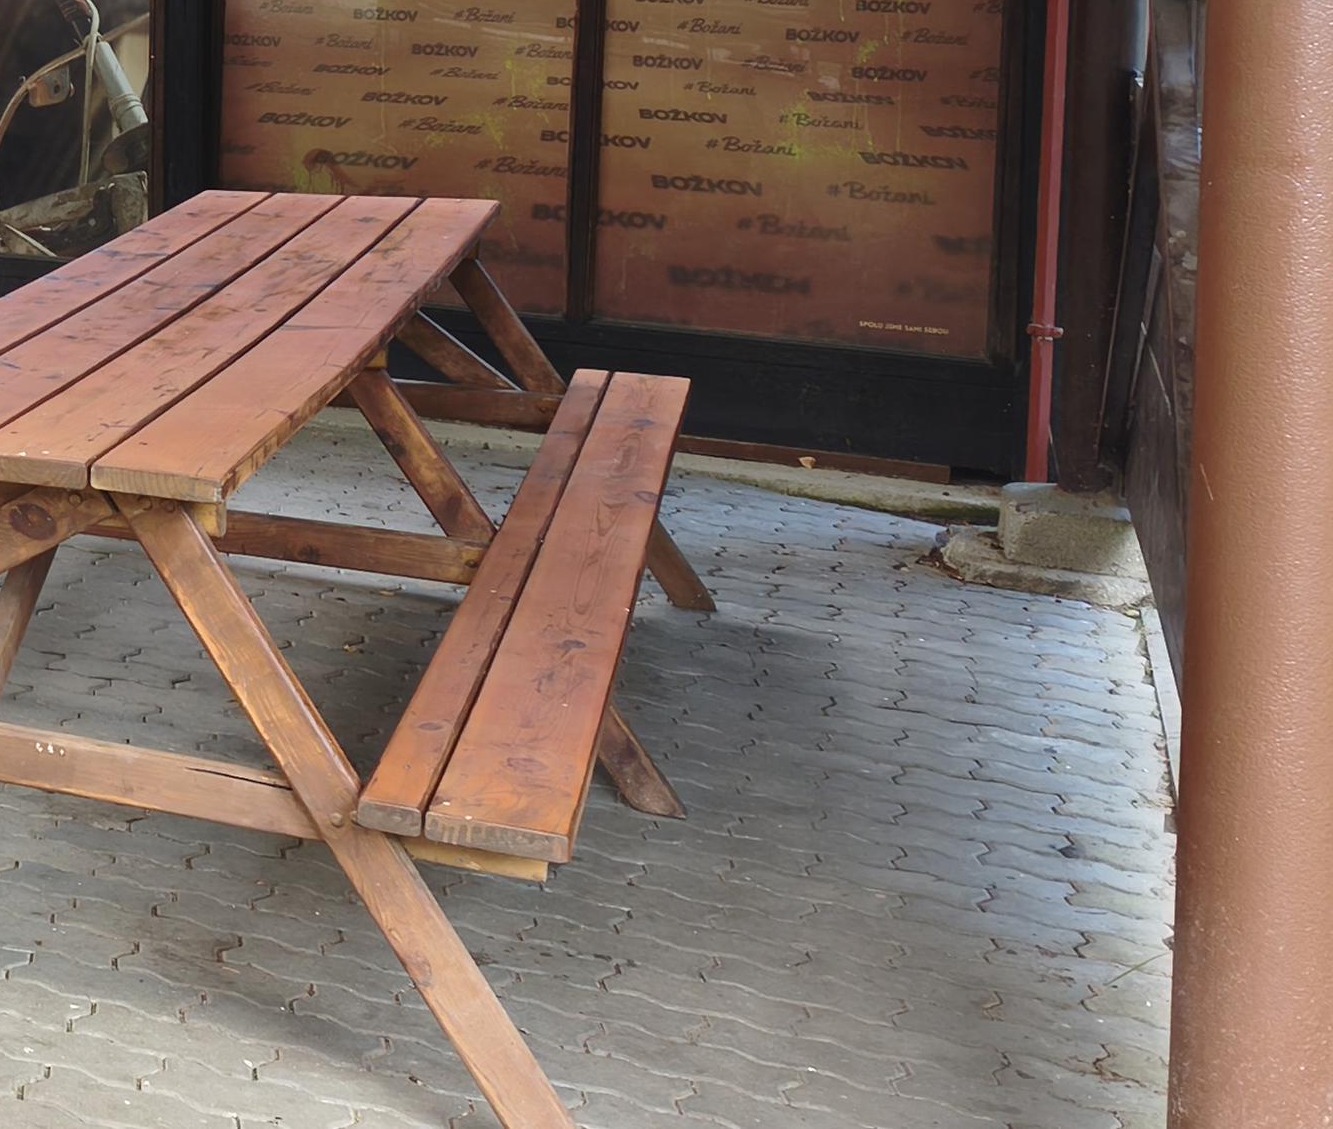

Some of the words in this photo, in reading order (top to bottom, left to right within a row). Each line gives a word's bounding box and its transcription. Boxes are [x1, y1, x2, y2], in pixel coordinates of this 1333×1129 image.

[353, 6, 419, 23] BOŽKOV
[784, 26, 860, 45] BOŽKOV
[411, 42, 479, 58] BOŽKOV
[632, 53, 705, 71] BOŽKOV
[359, 90, 448, 107] BOŽKOV
[257, 111, 353, 130] BOŽKOV
[637, 107, 729, 125] BOŽKOV
